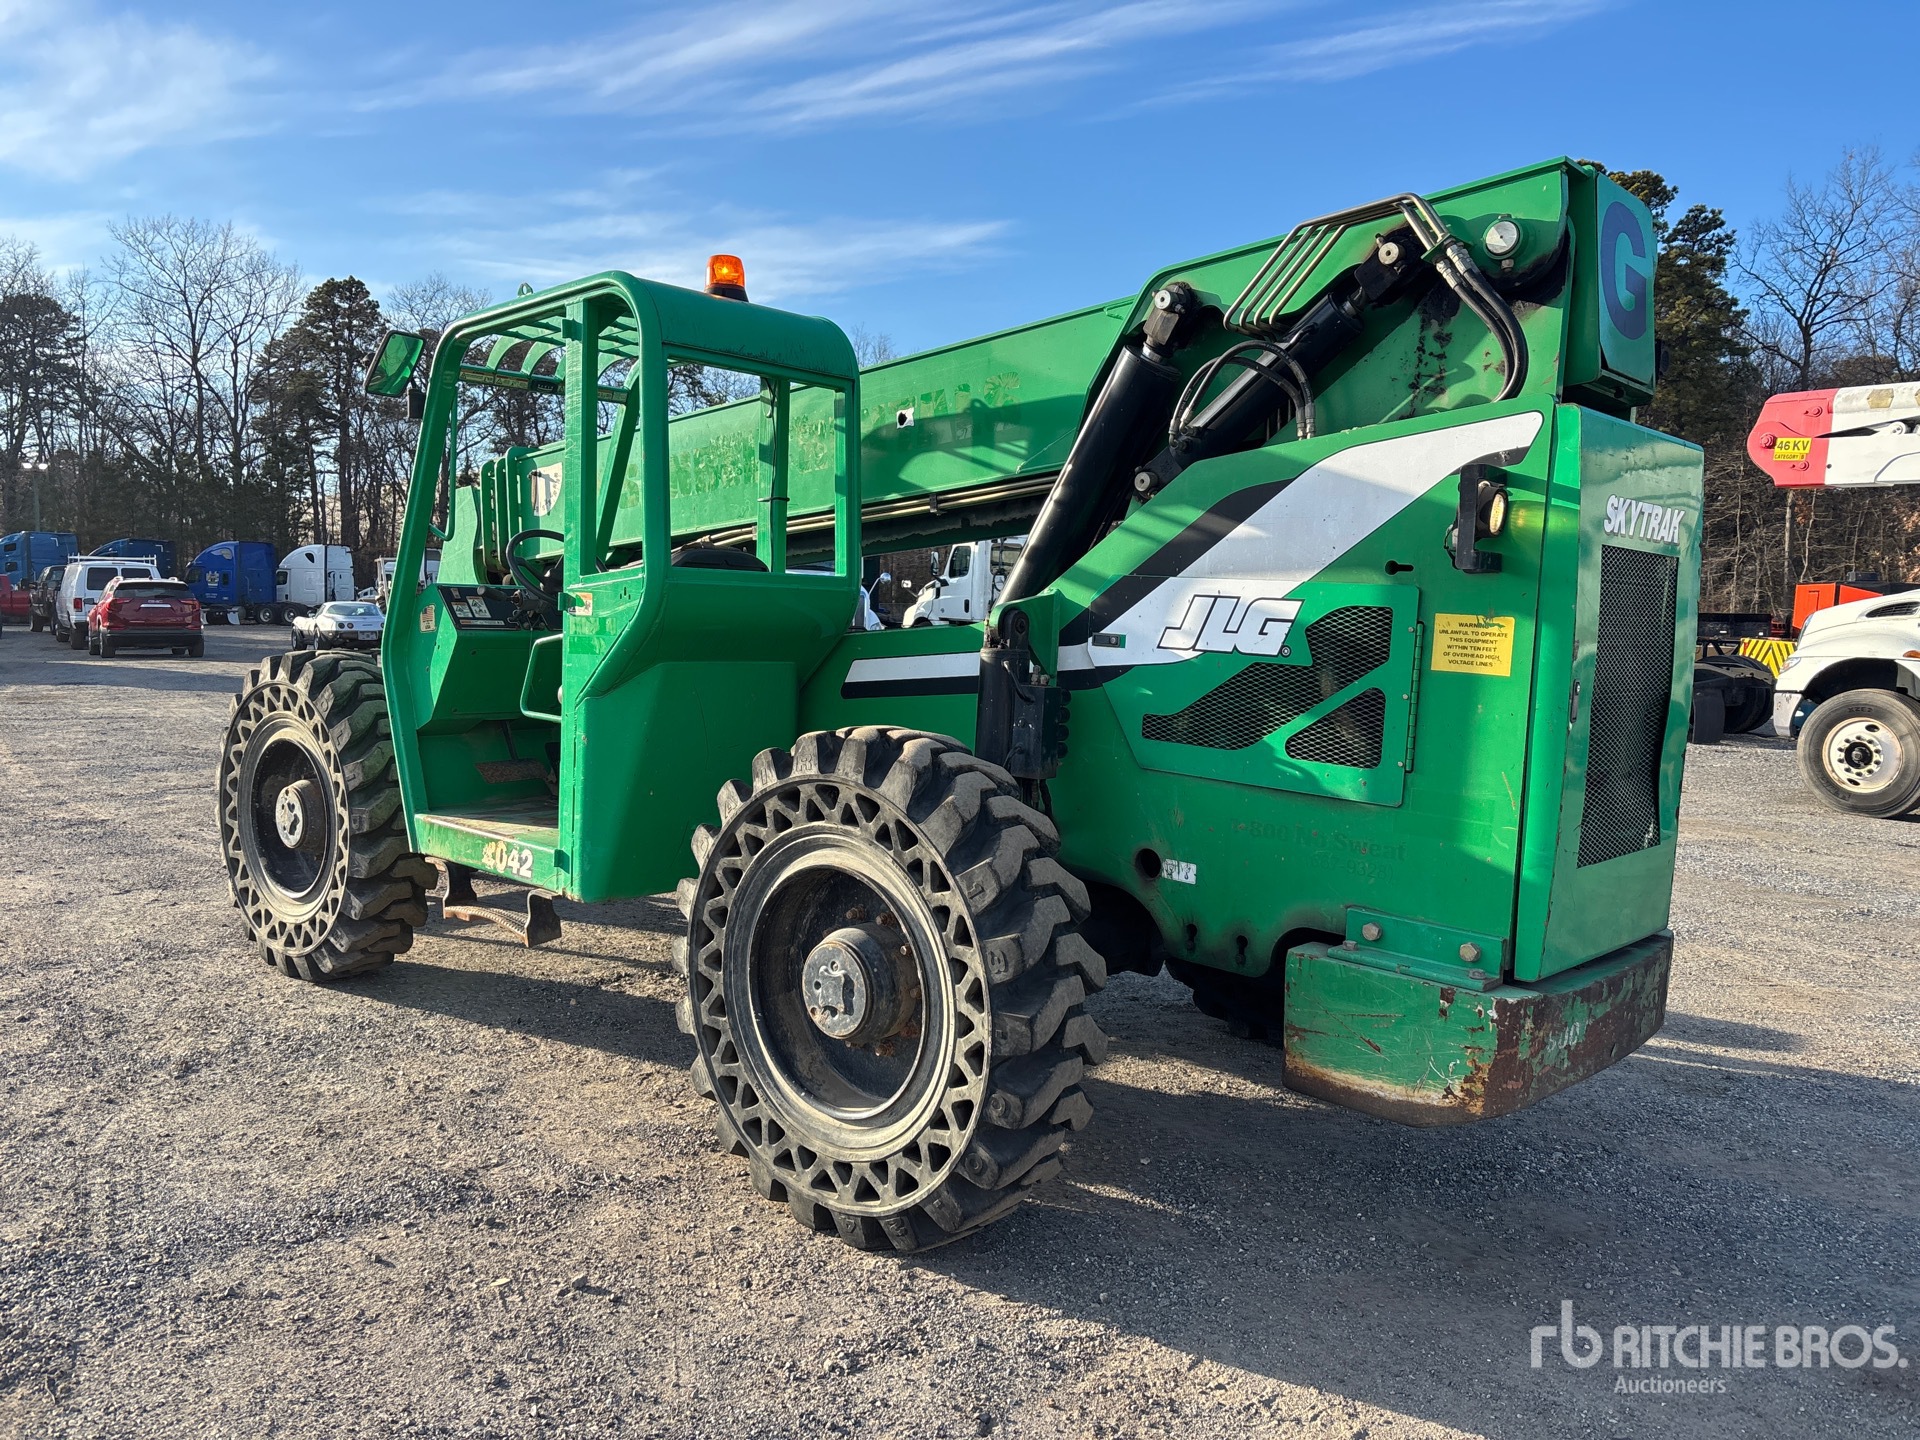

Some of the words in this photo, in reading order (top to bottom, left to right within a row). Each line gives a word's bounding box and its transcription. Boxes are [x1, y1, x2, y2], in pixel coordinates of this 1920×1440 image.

[1601, 201, 1647, 341] G
[1777, 440, 1791, 451] 46
[1792, 440, 1810, 451] KV
[1603, 494, 1685, 546] SKYTRAK
[1157, 594, 1305, 657] JLG
[1464, 637, 1498, 645] EQUIPMENT
